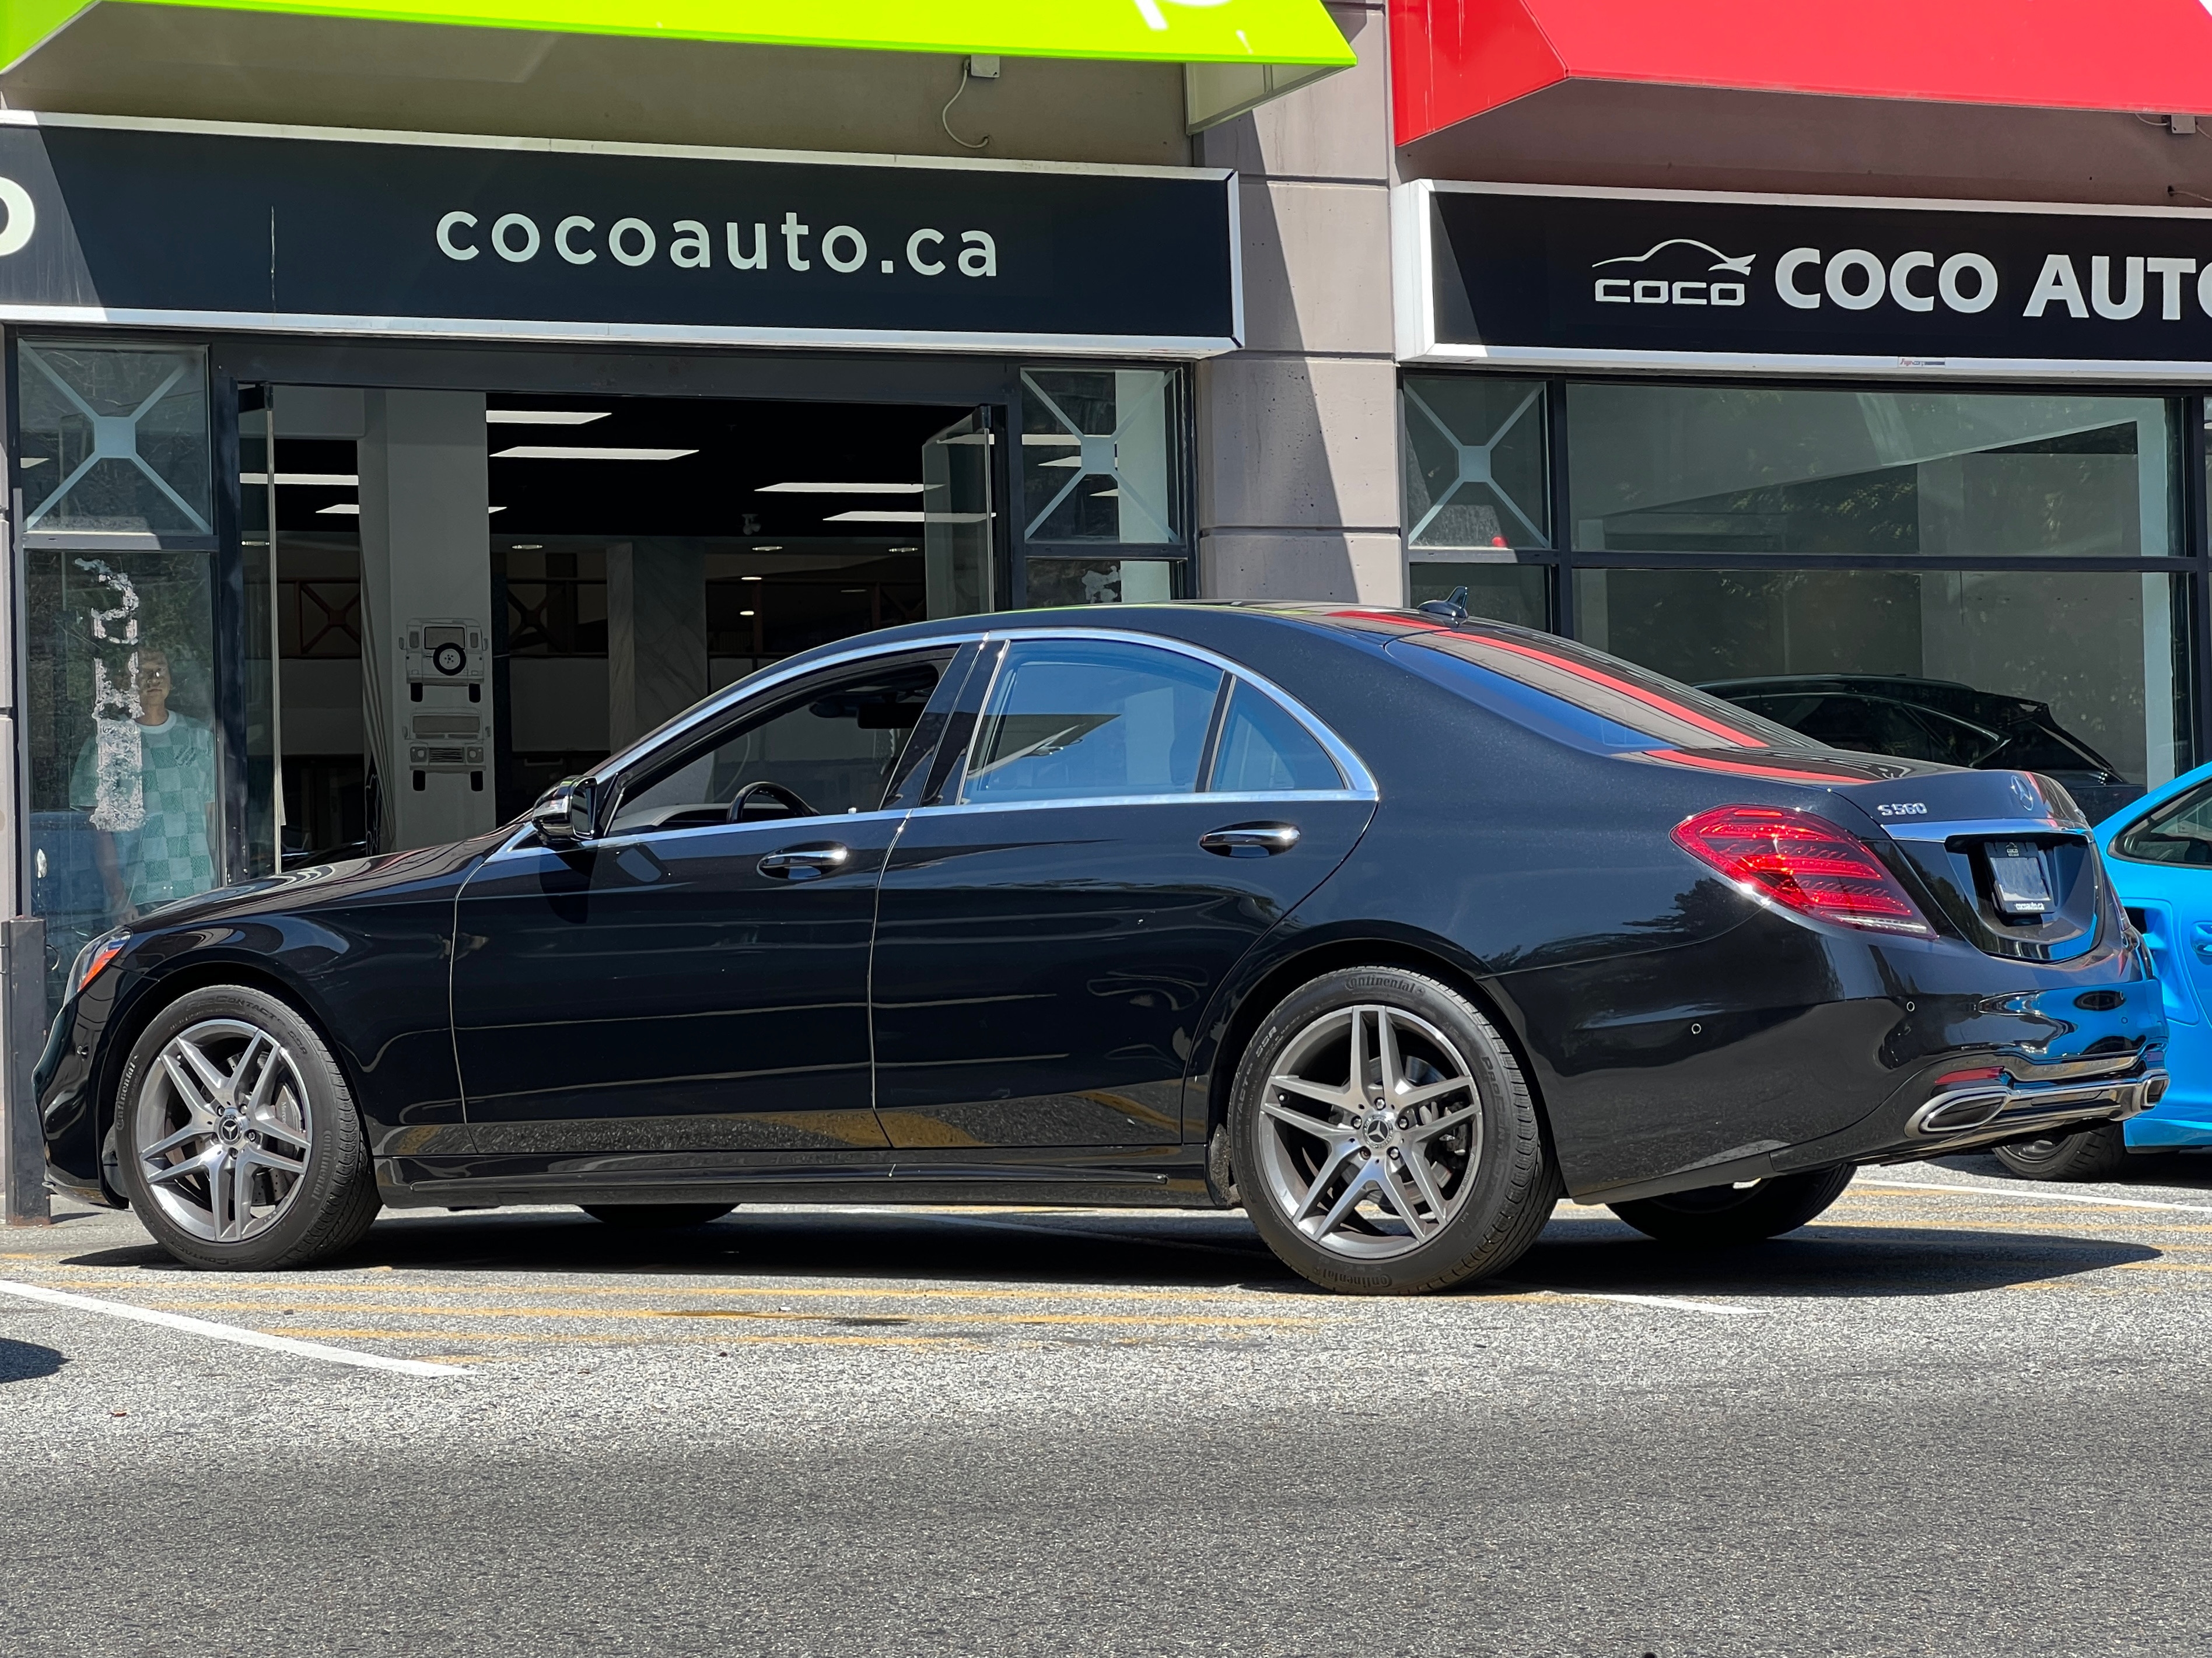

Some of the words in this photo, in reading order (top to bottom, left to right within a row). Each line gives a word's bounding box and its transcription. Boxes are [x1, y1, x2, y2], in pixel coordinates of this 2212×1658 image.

[436, 211, 997, 277] cocoauto.ca
[1595, 279, 1746, 306] COCO
[1775, 247, 1998, 314] COCO
[2023, 254, 2212, 320] AUT
[1345, 975, 1416, 993] Continental
[1255, 1026, 1277, 1058] SSR
[117, 1061, 136, 1131] Continental
[311, 1130, 332, 1201] Continental
[1322, 1268, 1393, 1288] Continental
